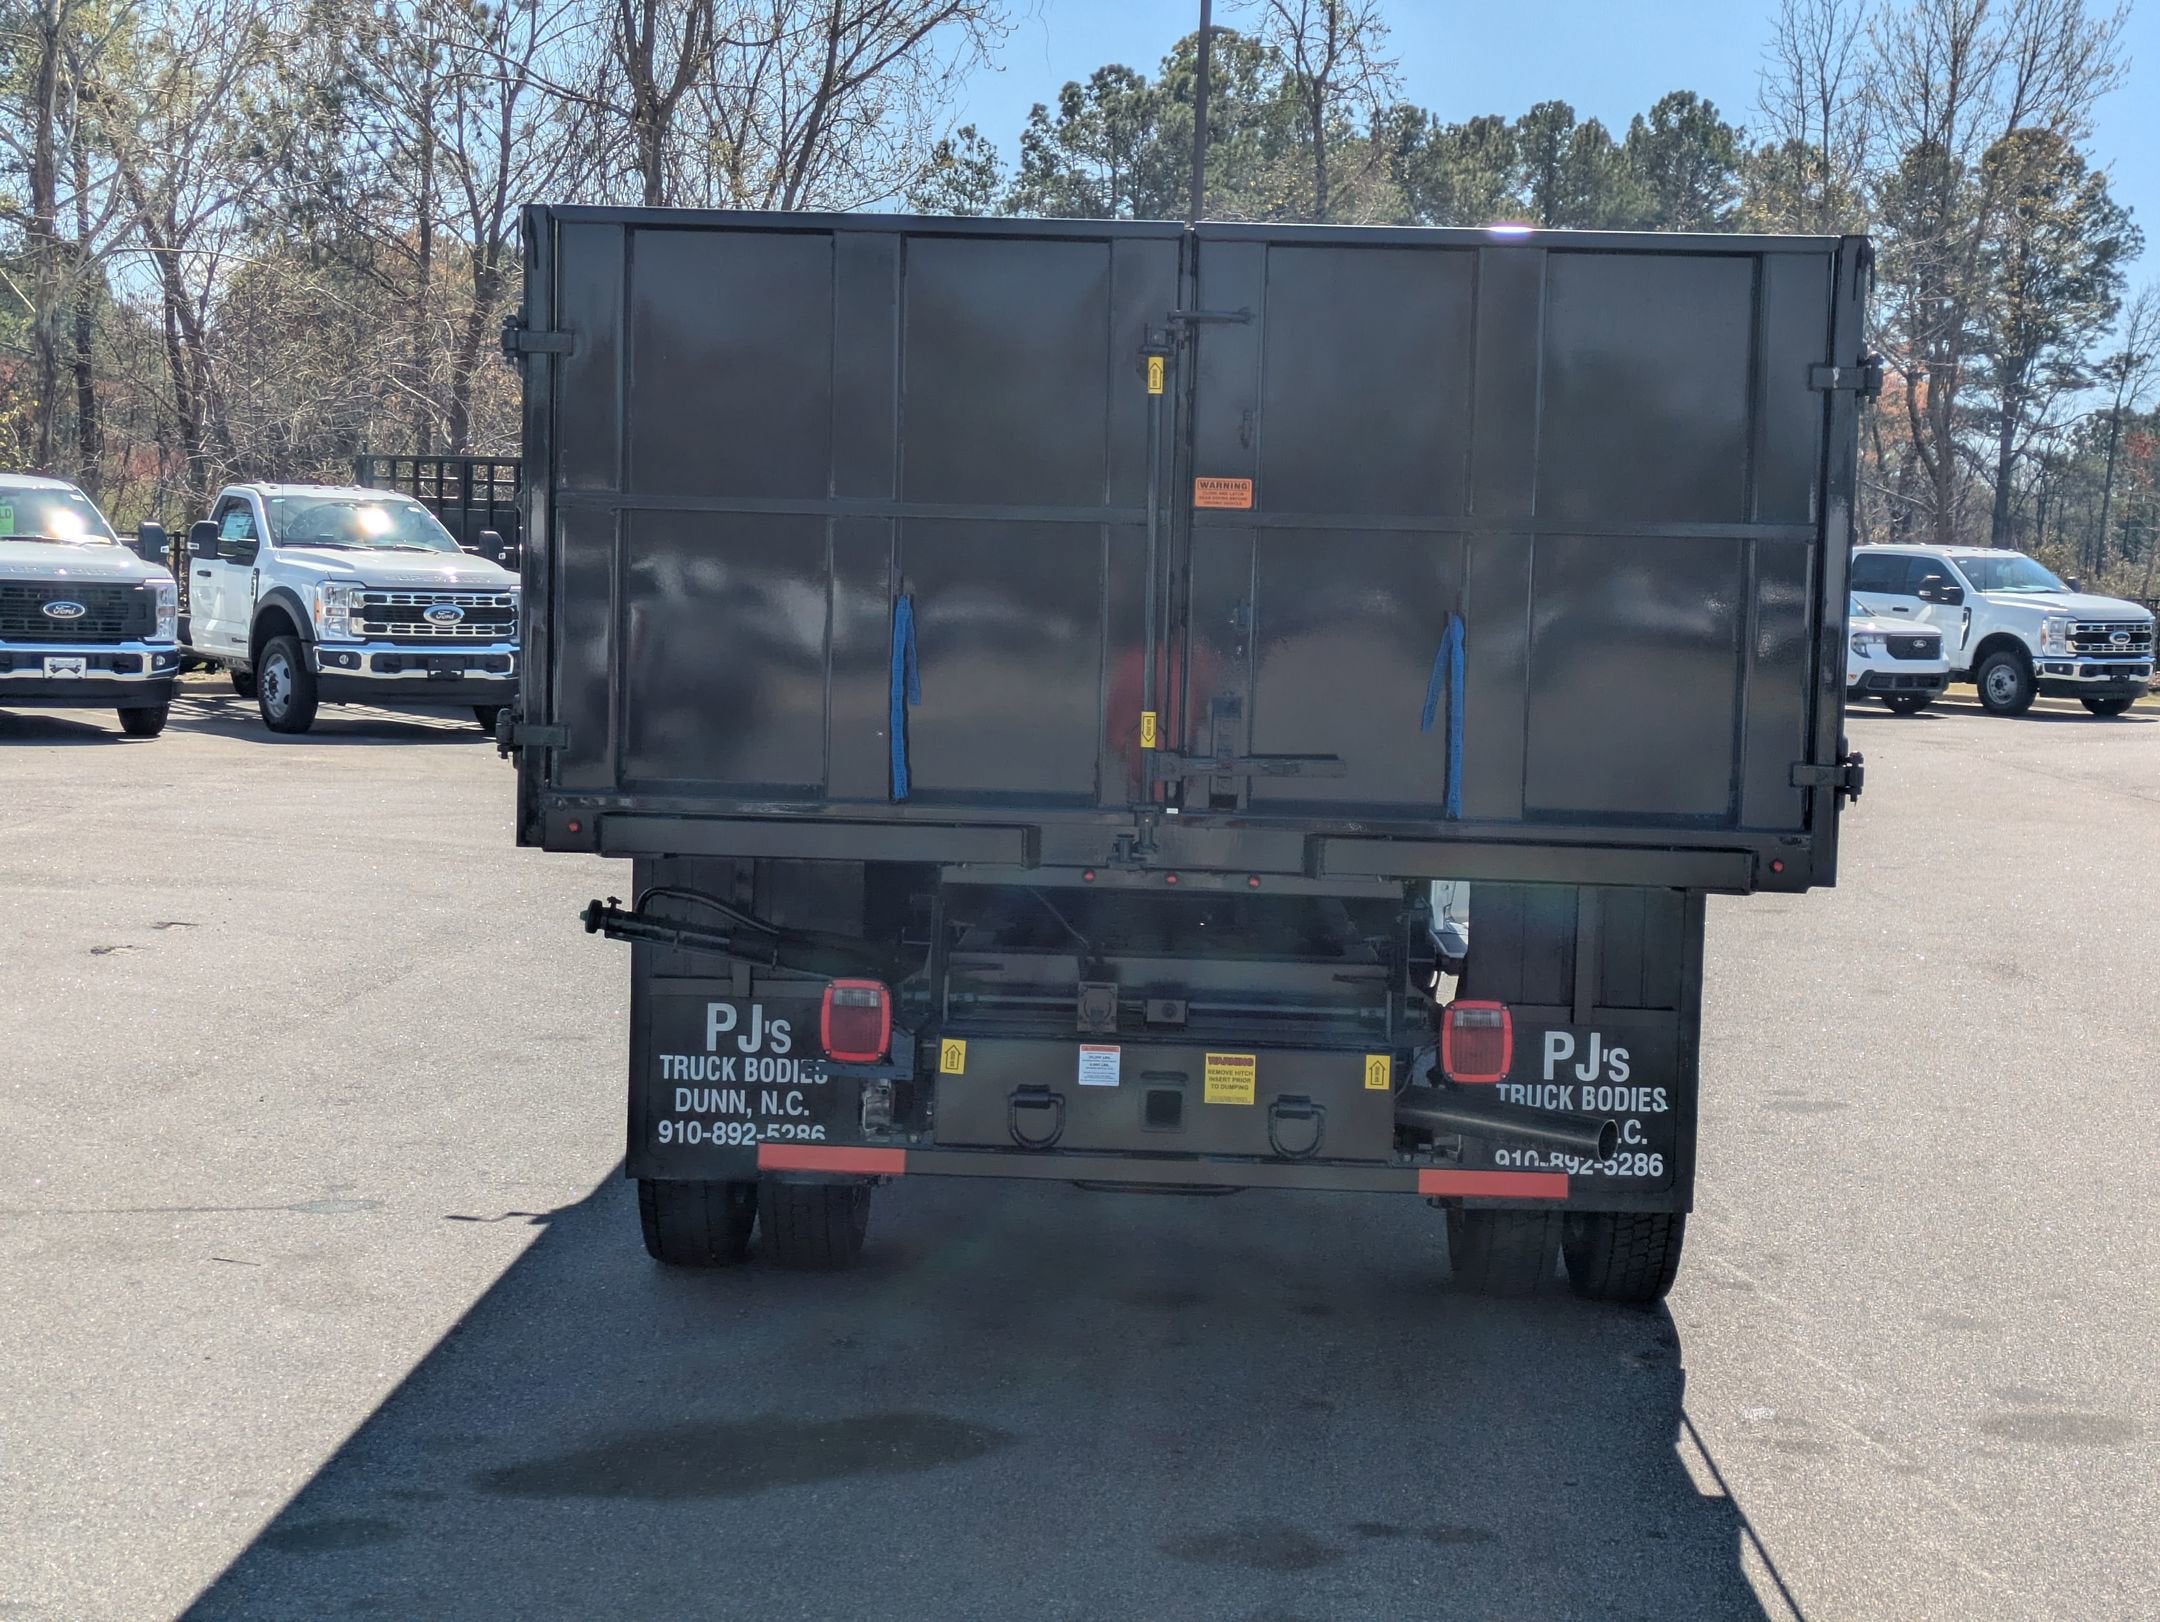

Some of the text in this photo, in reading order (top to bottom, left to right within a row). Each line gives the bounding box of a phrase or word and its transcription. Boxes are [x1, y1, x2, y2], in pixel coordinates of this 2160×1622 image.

[1200, 481, 1248, 490] WARNING
[659, 1054, 737, 1082] TRUCK
[1220, 1083, 1249, 1091] DUMPING
[1495, 1083, 1667, 1112] TRUCK BODIES
[674, 1087, 810, 1119] DUNN, N.C.
[657, 1119, 827, 1146] 910-892-5286
